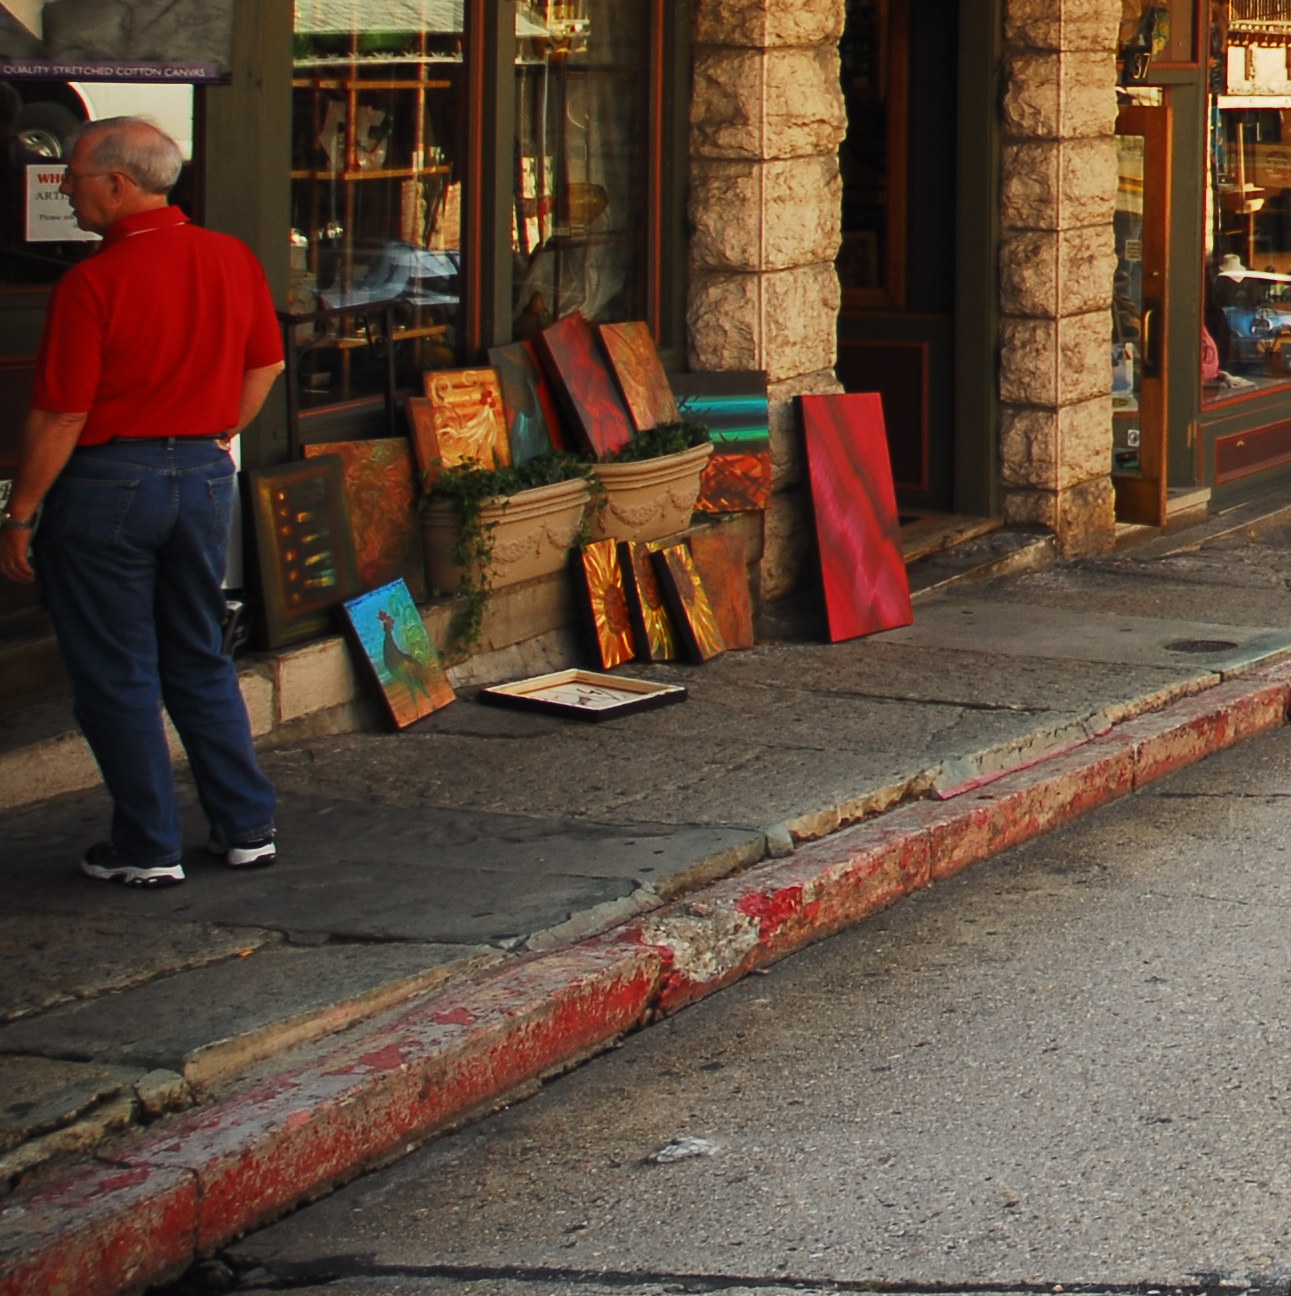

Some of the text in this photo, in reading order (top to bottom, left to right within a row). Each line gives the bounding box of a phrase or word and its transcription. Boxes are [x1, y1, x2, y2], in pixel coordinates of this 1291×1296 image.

[3, 65, 206, 78] QUALITY STRETCHED COTTON CANVAS
